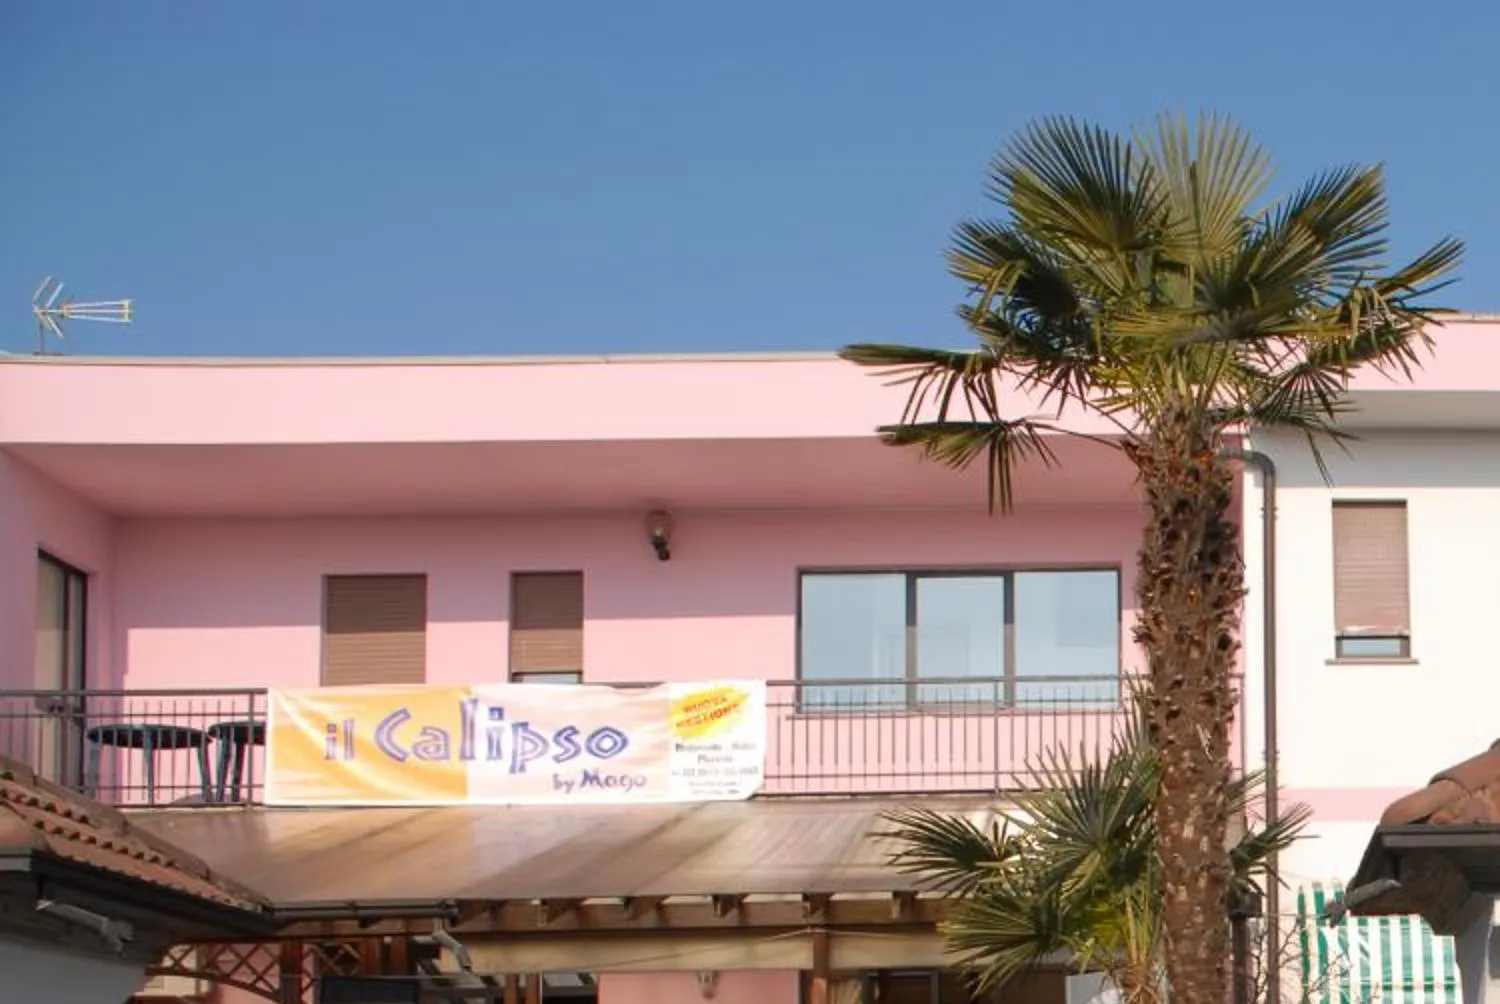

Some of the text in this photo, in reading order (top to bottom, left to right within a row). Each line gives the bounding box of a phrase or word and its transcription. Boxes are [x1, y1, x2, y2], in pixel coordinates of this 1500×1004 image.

[324, 697, 630, 775] il Calipso
[552, 773, 575, 793] by
[578, 769, 647, 792] Mago
